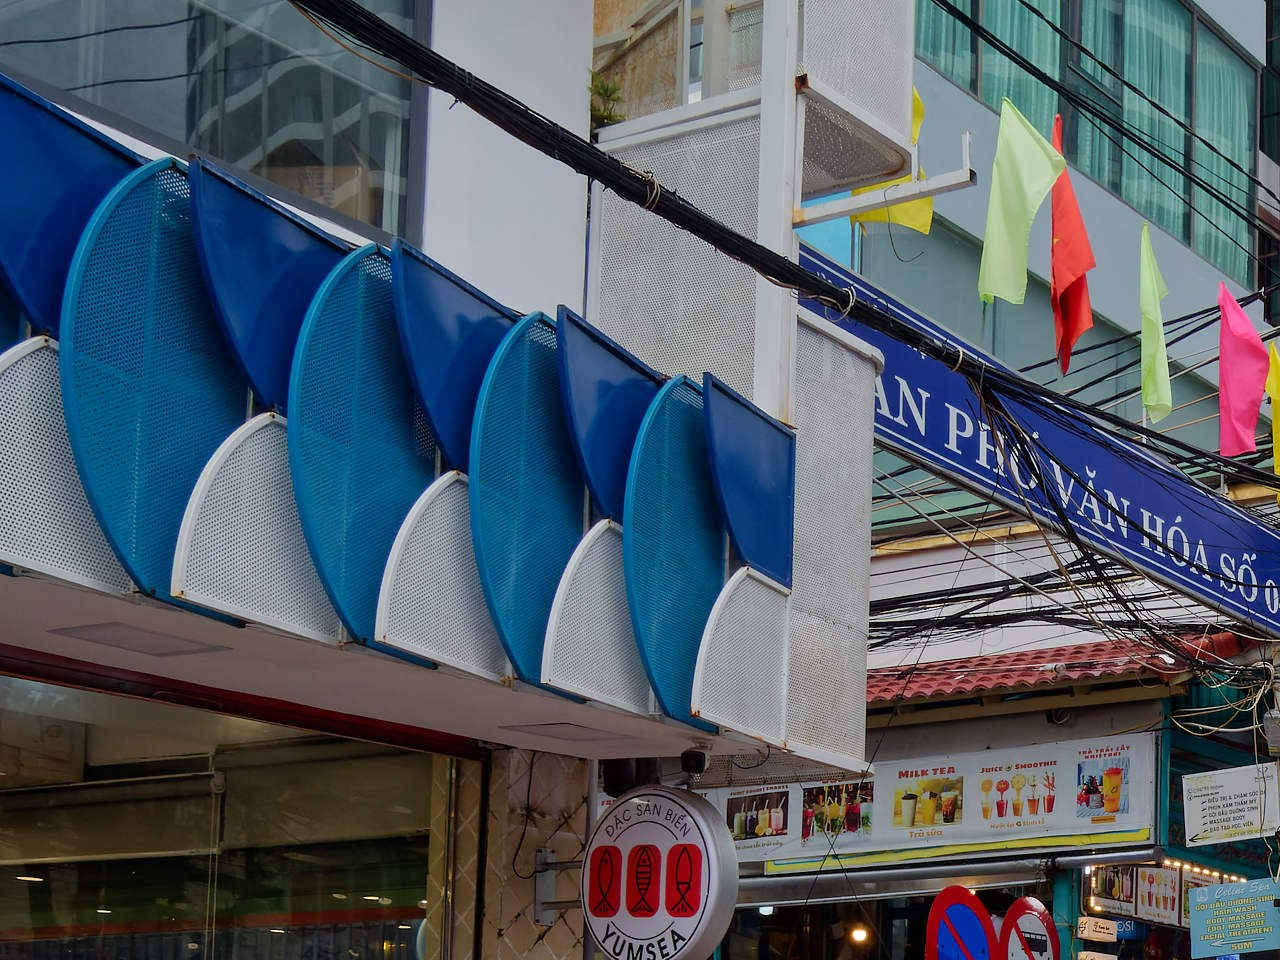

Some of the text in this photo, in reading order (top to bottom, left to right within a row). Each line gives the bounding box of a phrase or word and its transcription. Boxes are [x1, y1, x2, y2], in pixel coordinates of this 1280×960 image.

[1139, 507, 1214, 583] HÓA
[1219, 553, 1258, 602] SỐ
[898, 765, 956, 779] MILK TEA
[980, 760, 1058, 774] JUICE SMOOTHIE
[604, 808, 633, 838] ĐẶC
